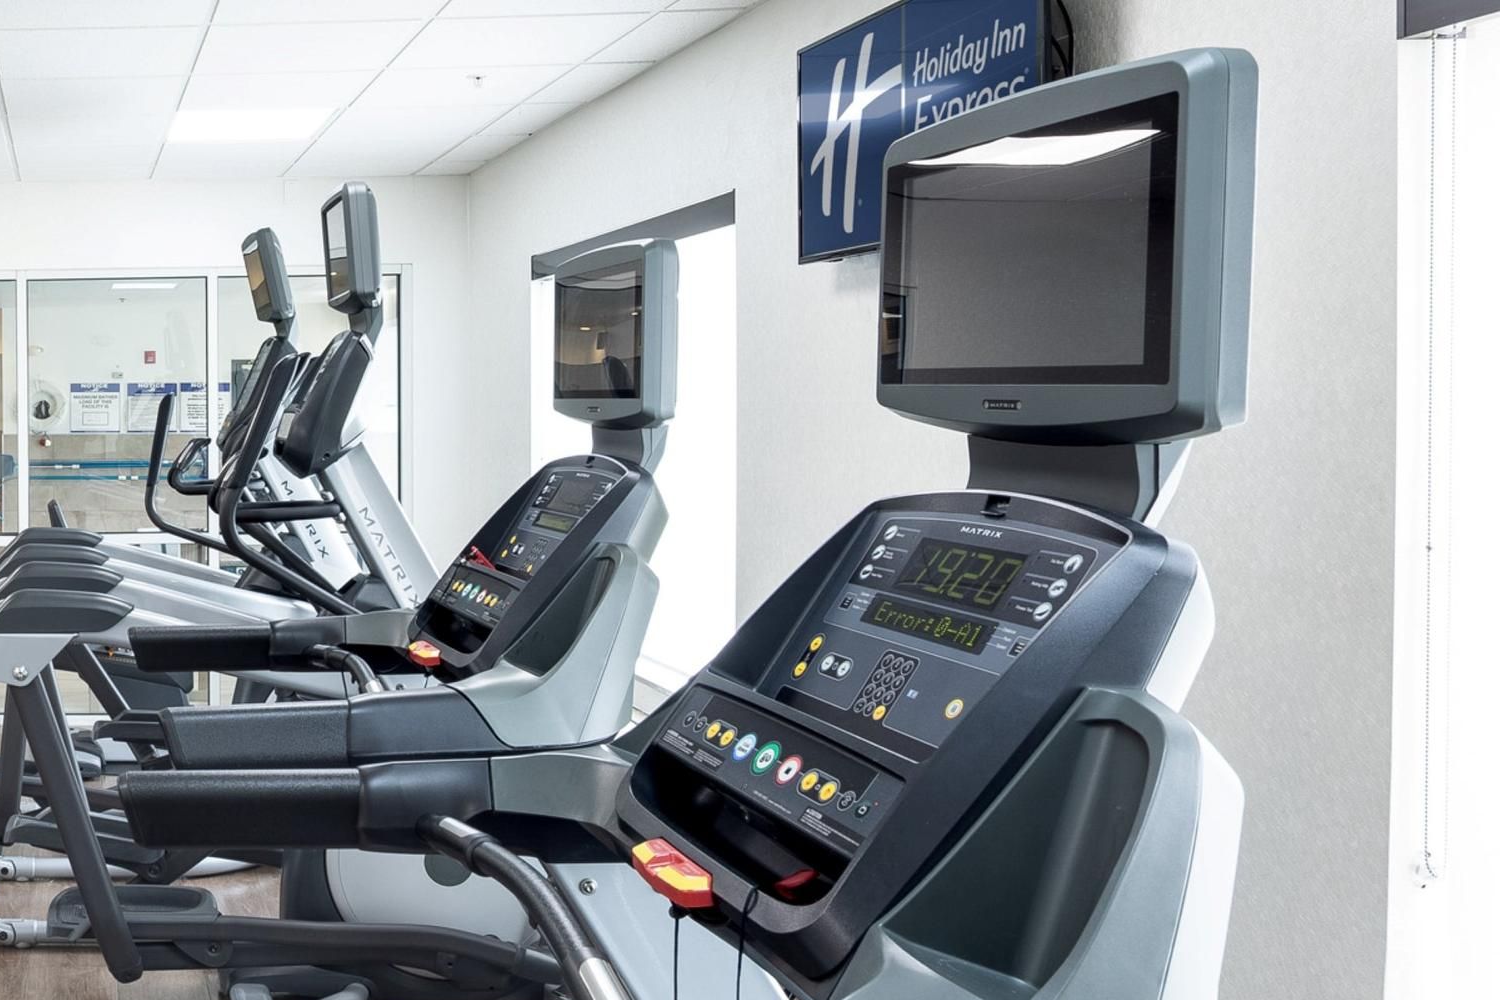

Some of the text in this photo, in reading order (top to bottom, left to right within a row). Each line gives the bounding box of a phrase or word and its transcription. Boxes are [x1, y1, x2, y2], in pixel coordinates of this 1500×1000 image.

[913, 19, 1026, 87] Holiday Inn
[281, 480, 329, 559] MRIX
[960, 526, 1003, 539] MATRIX
[358, 507, 420, 608] MATRIX
